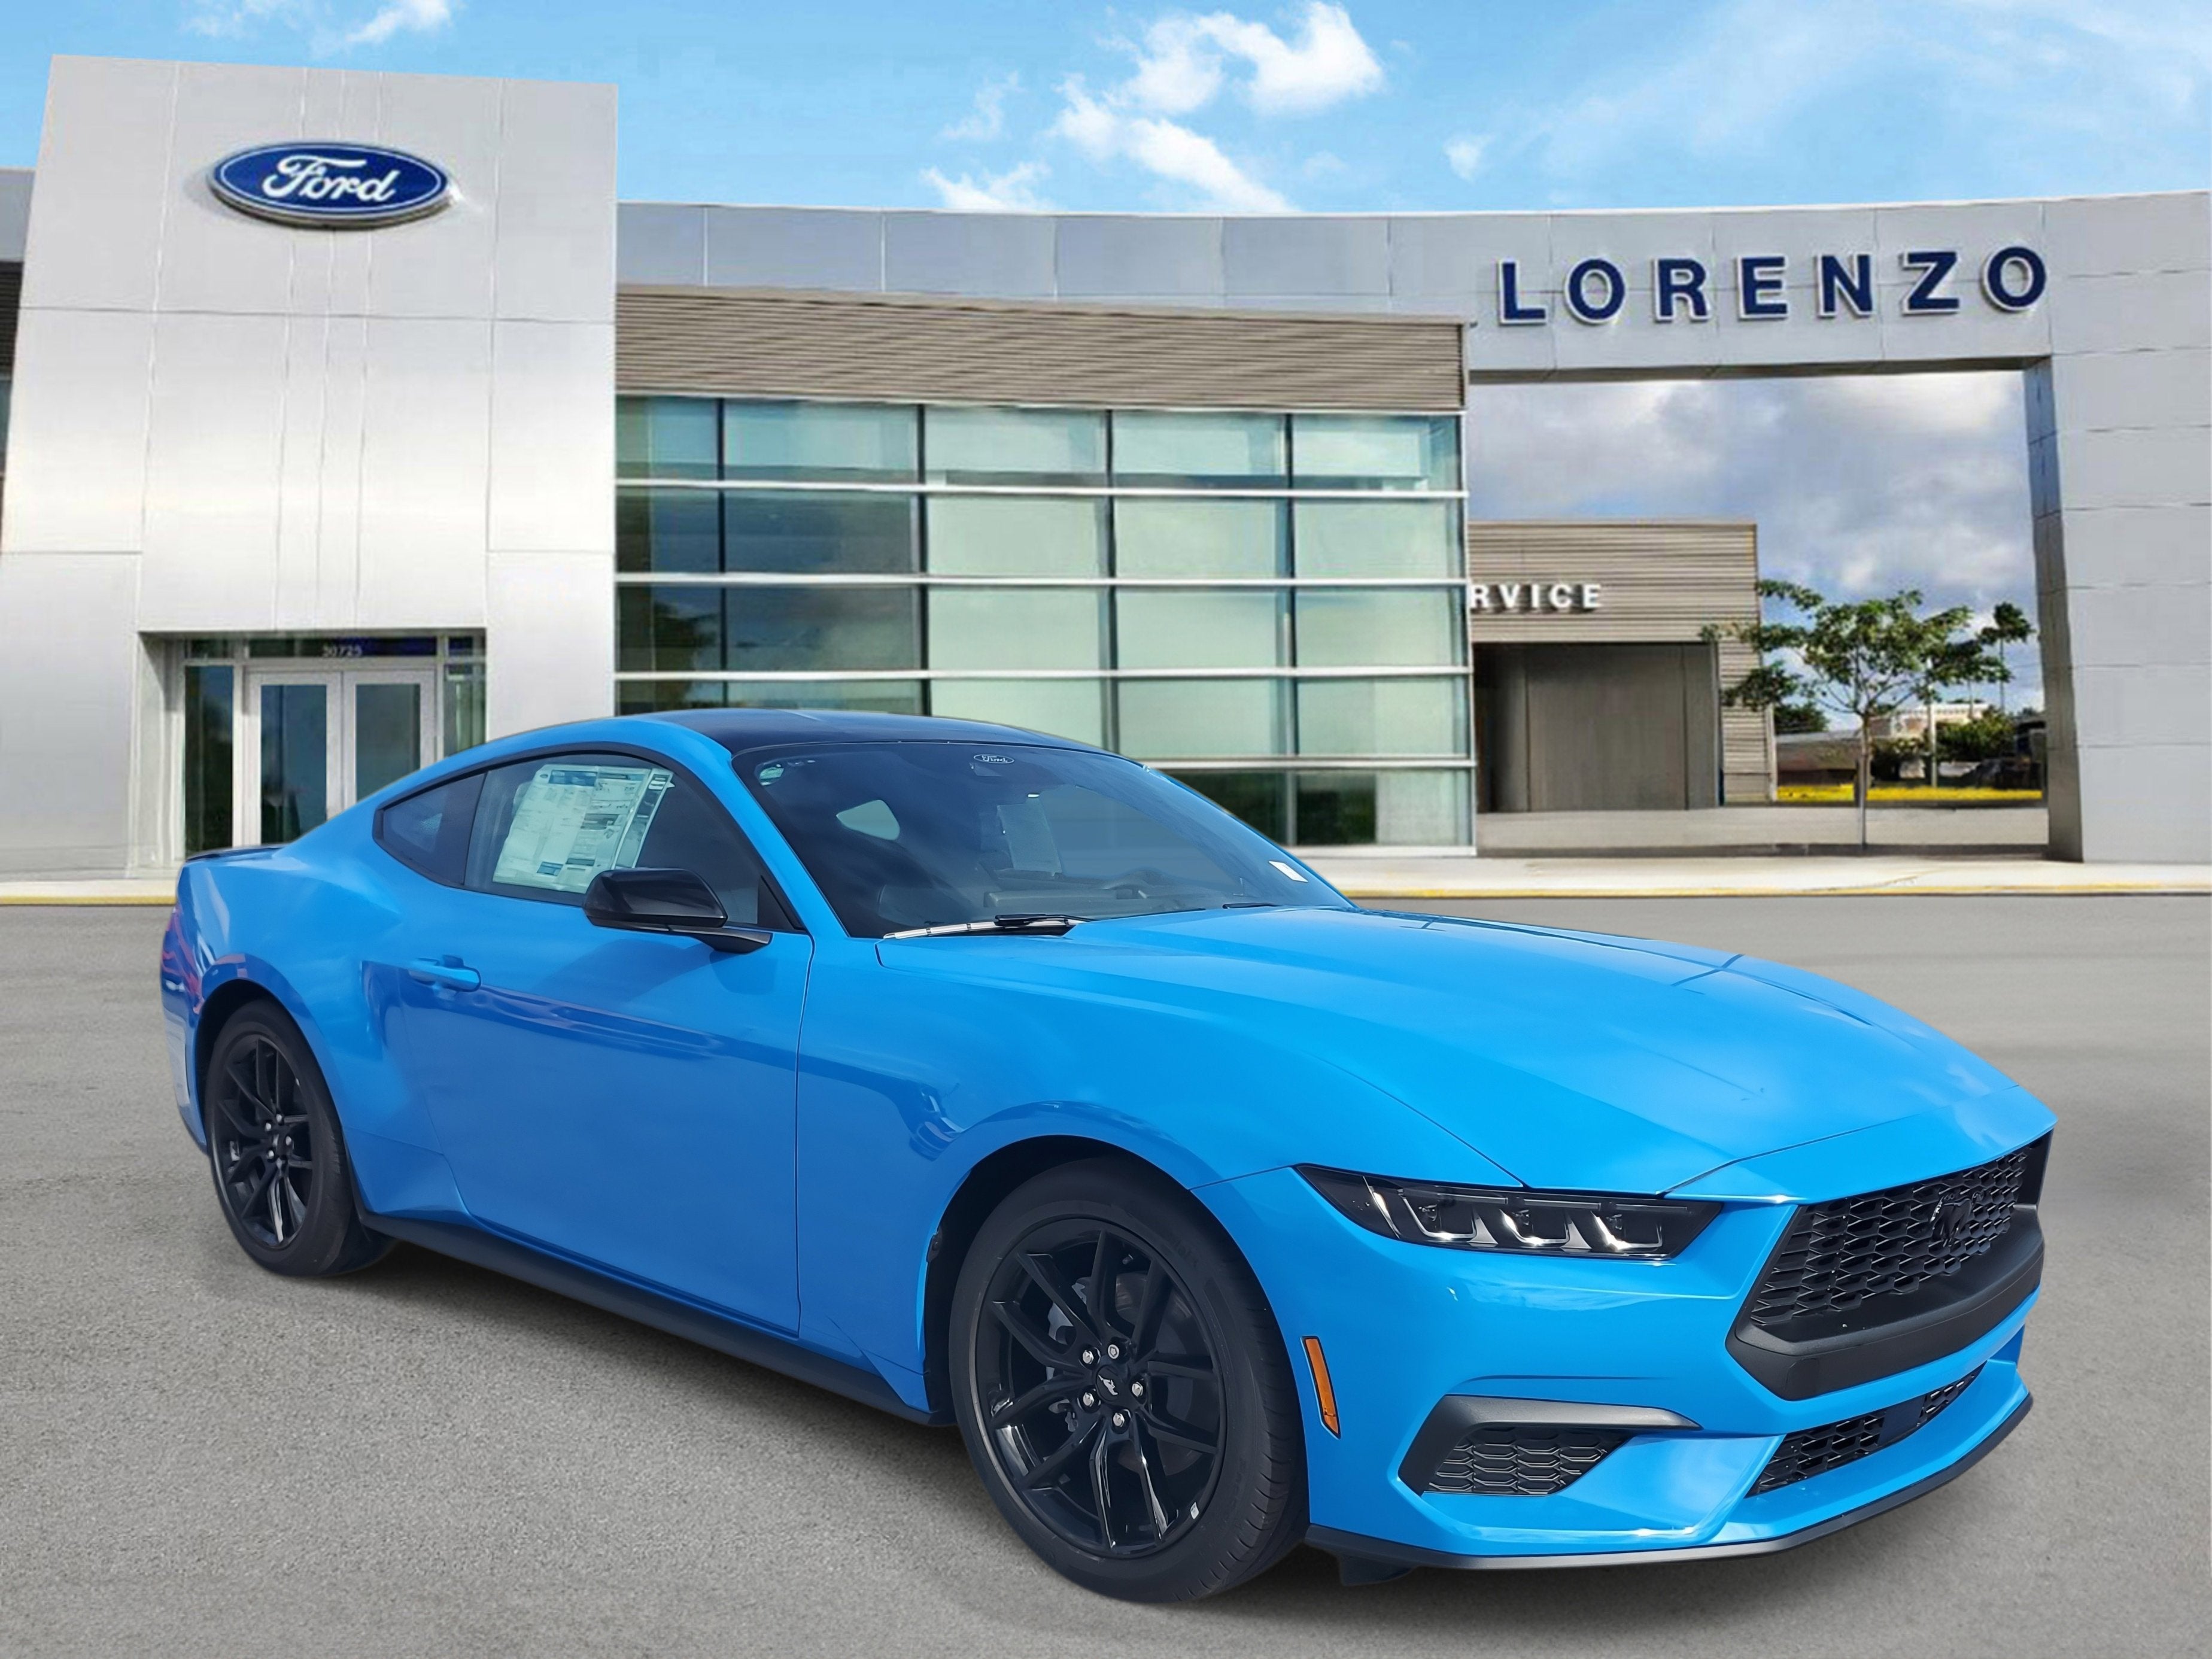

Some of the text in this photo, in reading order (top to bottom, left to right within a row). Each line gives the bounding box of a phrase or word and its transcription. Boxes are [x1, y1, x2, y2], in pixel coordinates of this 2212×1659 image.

[262, 154, 400, 202] Ford
[1499, 246, 2047, 324] LORENZO
[981, 755, 1008, 763] Ford
